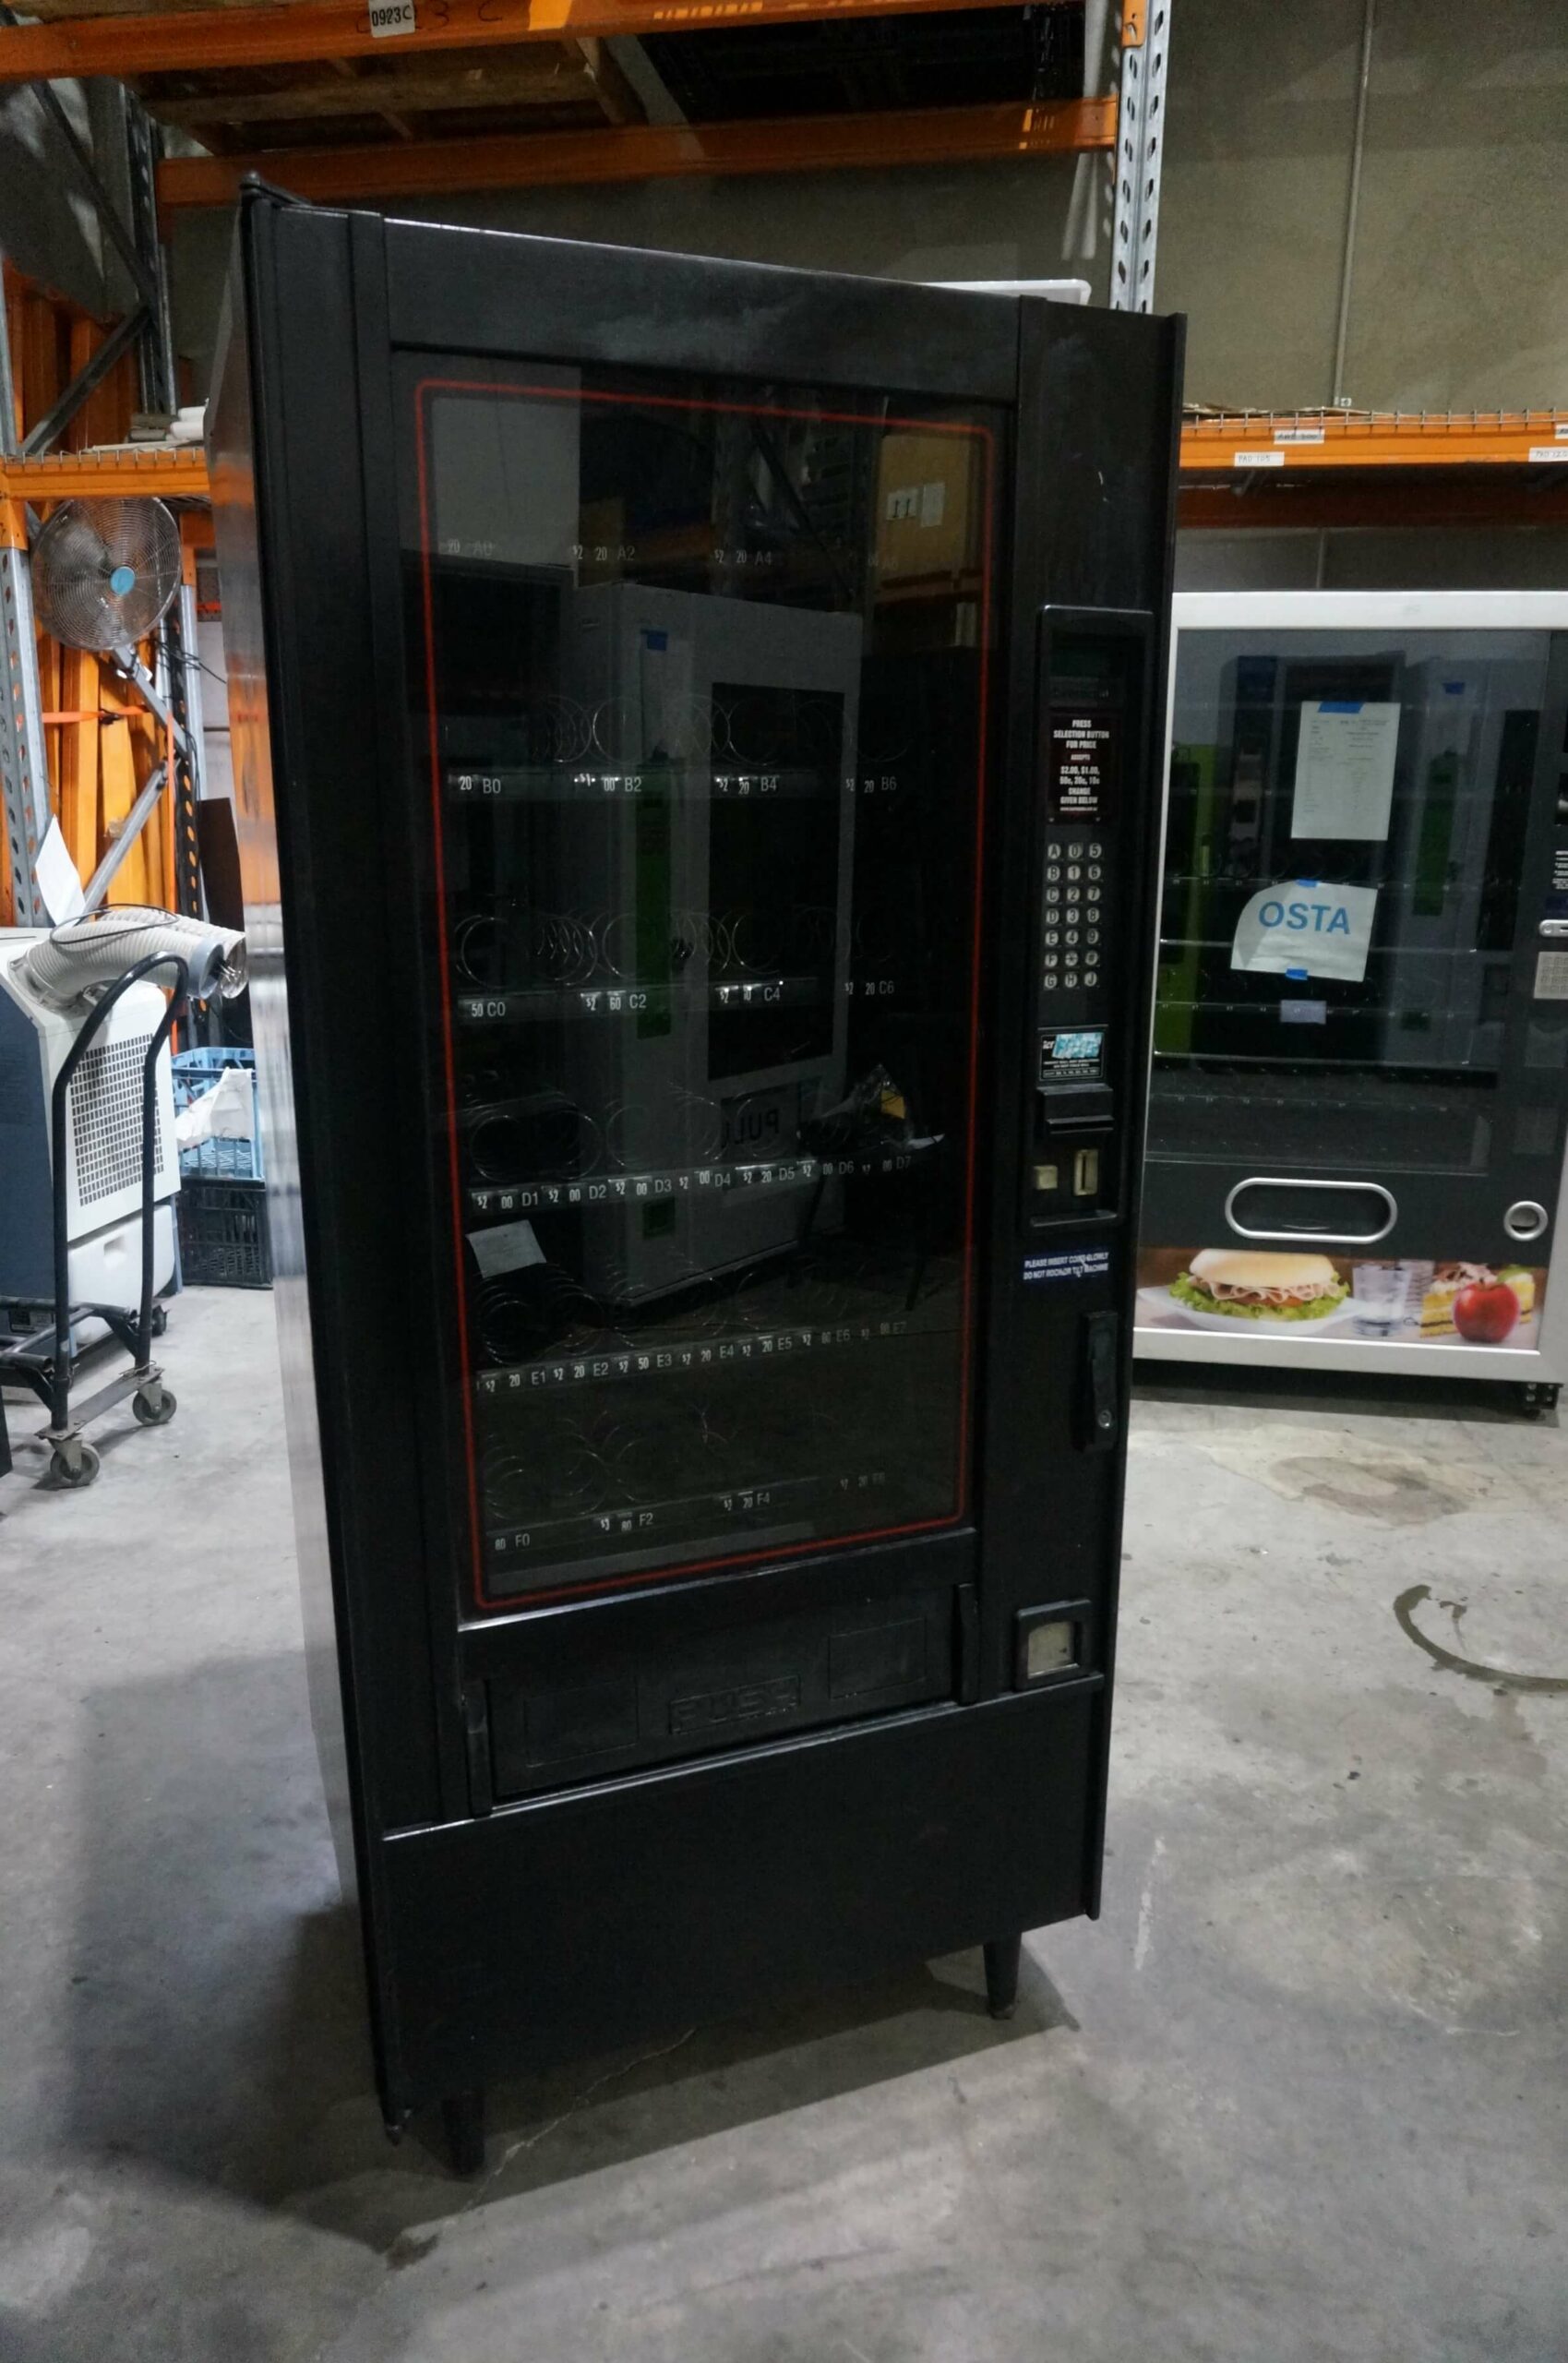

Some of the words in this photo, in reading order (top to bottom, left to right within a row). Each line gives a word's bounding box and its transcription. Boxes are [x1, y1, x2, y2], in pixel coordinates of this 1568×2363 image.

[371, 4, 412, 27] 0923C
[595, 546, 607, 561] 20
[617, 546, 635, 562] A2
[736, 549, 748, 564] 20
[754, 550, 772, 566] A4
[460, 775, 472, 791] 20
[624, 775, 642, 793] B2
[738, 781, 749, 796] 20
[760, 775, 777, 792] B4
[880, 775, 897, 791] B6
[1258, 900, 1351, 936] OSTA
[763, 986, 781, 1002] C4
[865, 981, 875, 996] 20
[879, 980, 895, 995] C6
[471, 1002, 485, 1017] 50
[609, 996, 621, 1011] 60
[629, 993, 647, 1009] C2
[501, 1195, 514, 1209] 00
[521, 1192, 539, 1207] D1
[569, 1188, 581, 1203] 00
[589, 1184, 606, 1200] D2
[636, 1182, 648, 1196] 00
[654, 1178, 673, 1193] D3
[700, 1170, 711, 1184] 00
[714, 1172, 731, 1188] D4
[761, 1170, 772, 1184] 20
[779, 1166, 796, 1182] D5
[838, 1160, 855, 1175] D6
[895, 1155, 912, 1170] D7
[509, 1373, 521, 1387] 20
[531, 1371, 546, 1385] E1
[573, 1364, 585, 1379] 20
[592, 1361, 609, 1377] E2
[638, 1356, 650, 1370] 50
[656, 1353, 673, 1368] E3
[700, 1349, 712, 1362] 20
[720, 1344, 735, 1360] E4
[761, 1338, 773, 1353] 20
[777, 1336, 793, 1350] E5
[835, 1328, 851, 1343] E6
[757, 1492, 770, 1506] F4
[639, 1512, 653, 1527] F2
